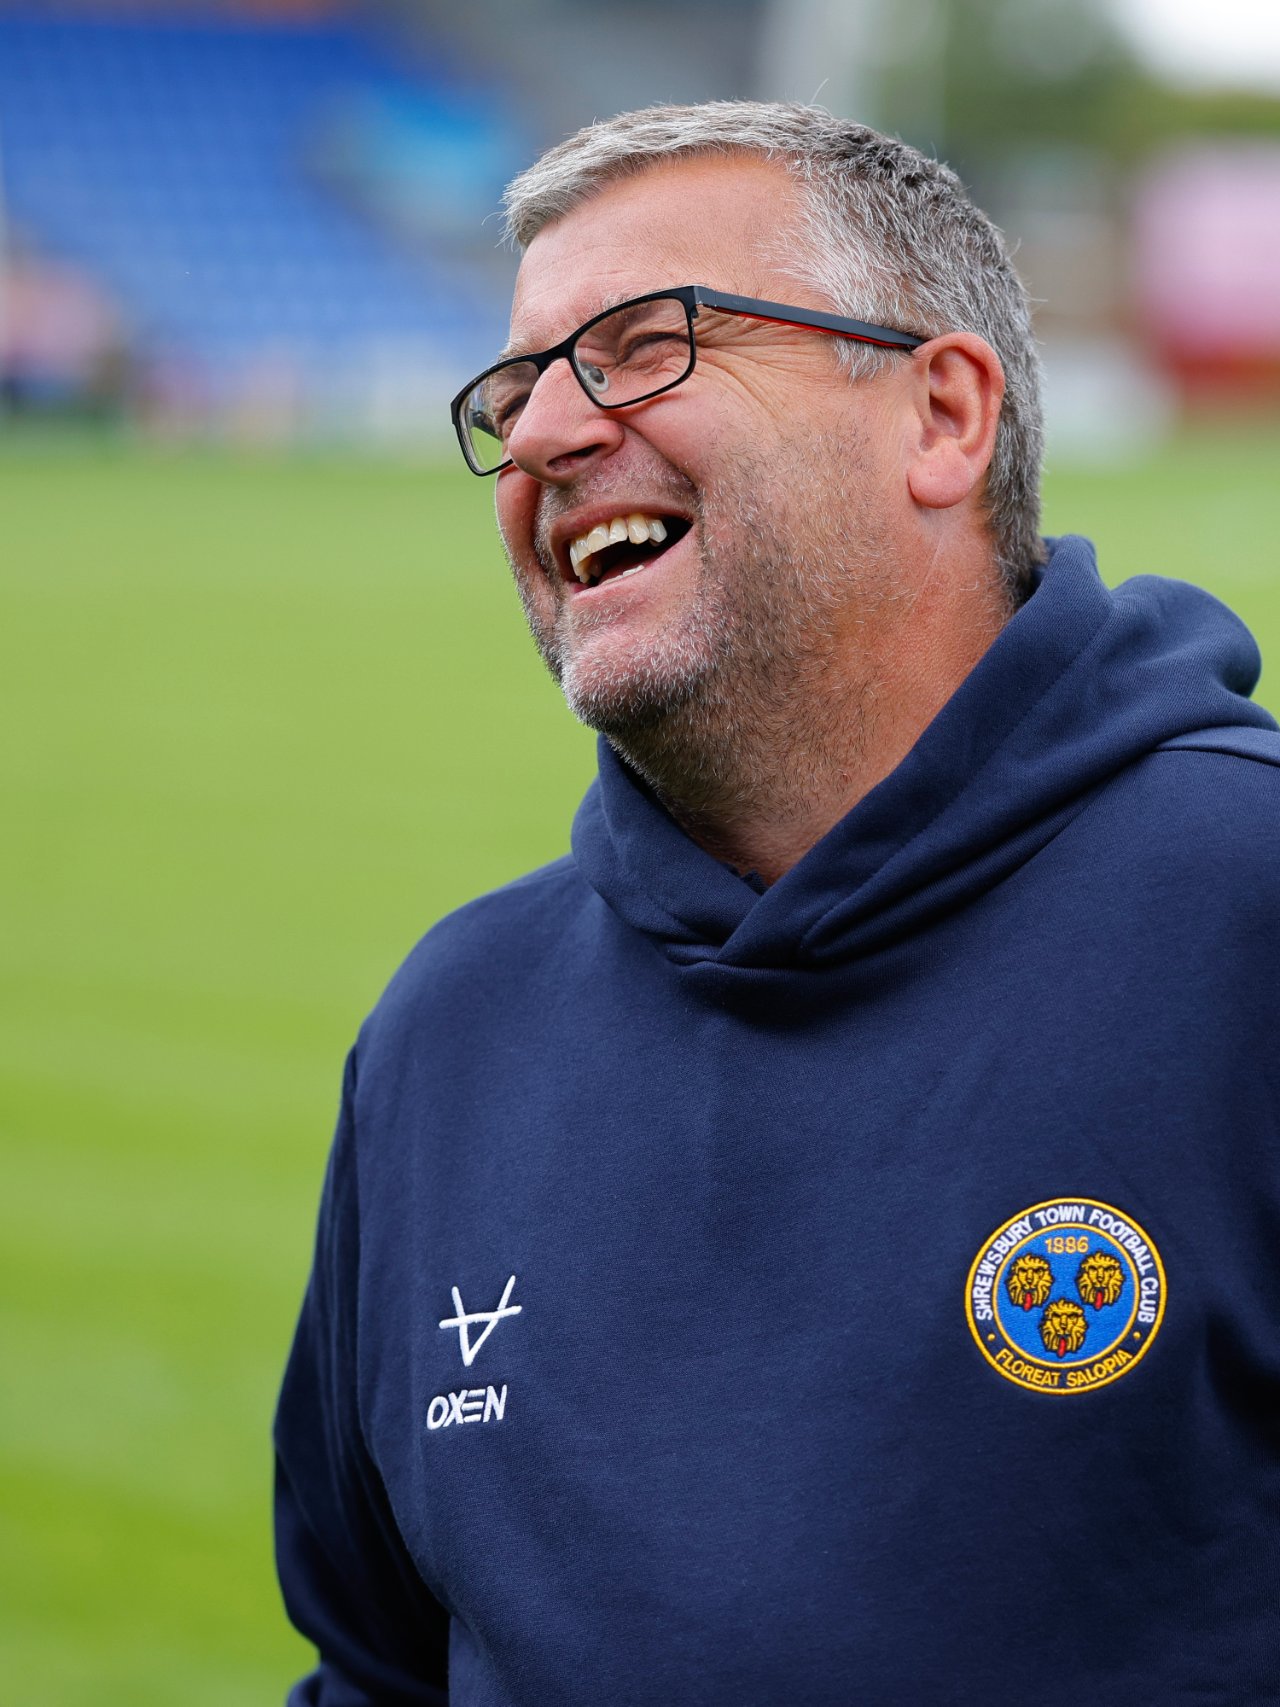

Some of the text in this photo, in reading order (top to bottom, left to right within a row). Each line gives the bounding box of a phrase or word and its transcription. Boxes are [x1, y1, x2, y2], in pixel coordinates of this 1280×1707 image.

[972, 1205, 1160, 1324] SHREWSBURY TOWN FOOTBALL CLUB
[1044, 1236, 1090, 1254] 1886
[994, 1347, 1134, 1387] FLOREAT SALOPIA
[426, 1384, 508, 1431] OXEN
